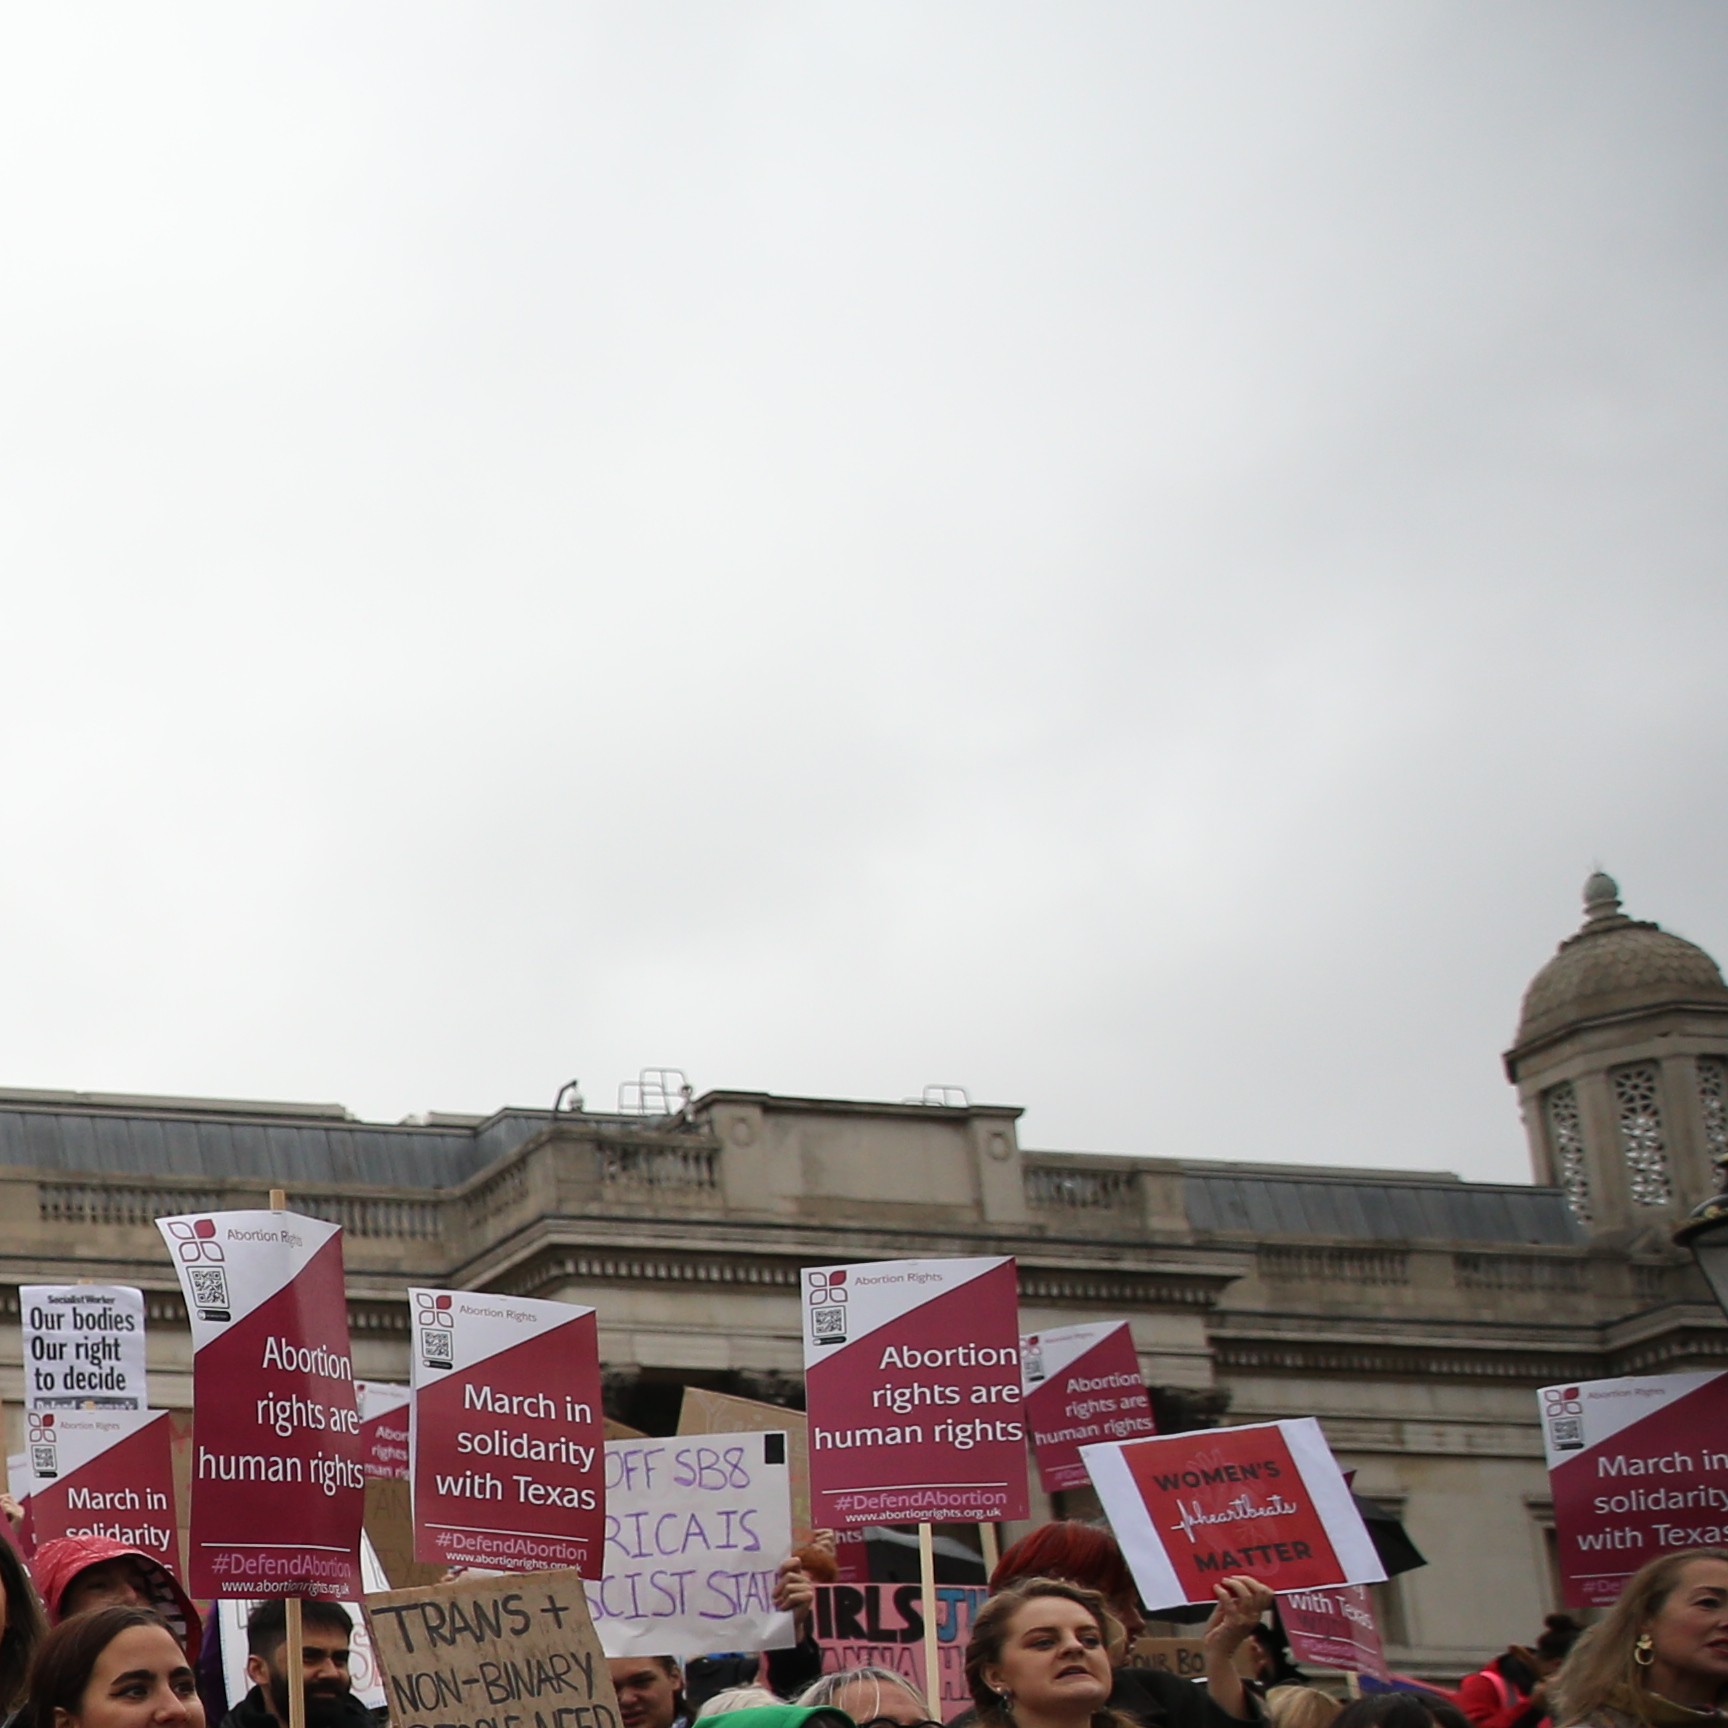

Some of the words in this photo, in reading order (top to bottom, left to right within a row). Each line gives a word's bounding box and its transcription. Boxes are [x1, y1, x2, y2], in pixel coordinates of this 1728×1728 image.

[30, 1307, 63, 1331] Our
[73, 1306, 135, 1333] bodies
[30, 1336, 67, 1362] Our
[75, 1337, 121, 1366] right
[262, 1336, 350, 1381] Abortion
[879, 1343, 1018, 1371] Abortion
[35, 1367, 55, 1391] to
[63, 1365, 126, 1391] decide
[1066, 1371, 1141, 1394] Abortion
[463, 1383, 556, 1421] March
[565, 1394, 592, 1424] in
[872, 1380, 961, 1414] rights
[970, 1383, 1020, 1403] are
[1065, 1396, 1116, 1418] rights
[1118, 1393, 1147, 1409] are
[257, 1391, 325, 1437] rights
[330, 1407, 359, 1435] are
[815, 1419, 922, 1450] human
[933, 1418, 1023, 1449] rights
[1035, 1425, 1099, 1446] human
[1103, 1415, 1153, 1437] rights
[457, 1429, 596, 1470] solidarity
[1597, 1453, 1695, 1478] March
[1703, 1450, 1728, 1475] in
[199, 1446, 301, 1483] human
[310, 1455, 364, 1496] rights
[674, 1446, 752, 1491] SB8
[1153, 1458, 1282, 1492] WOMEN'S
[67, 1487, 139, 1510] March
[146, 1489, 167, 1510] in
[436, 1470, 503, 1501] with
[511, 1476, 596, 1510] Texas
[834, 1489, 1007, 1511] #DefendAbortion
[1594, 1482, 1728, 1517] solidarity
[722, 1508, 762, 1552] IS
[845, 1507, 1001, 1523] www.abortionrights.org.uk
[65, 1524, 170, 1551] solidarity
[436, 1530, 587, 1561] #DefendAbortion
[1577, 1528, 1644, 1552] with
[212, 1553, 350, 1579] #DefendAbortion
[1193, 1539, 1313, 1574] MATTER
[371, 1595, 532, 1654] TRANS
[539, 1598, 570, 1631] +
[1288, 1590, 1332, 1616] with
[1334, 1595, 1375, 1630] Texas
[392, 1652, 596, 1714] NON-BINARY
